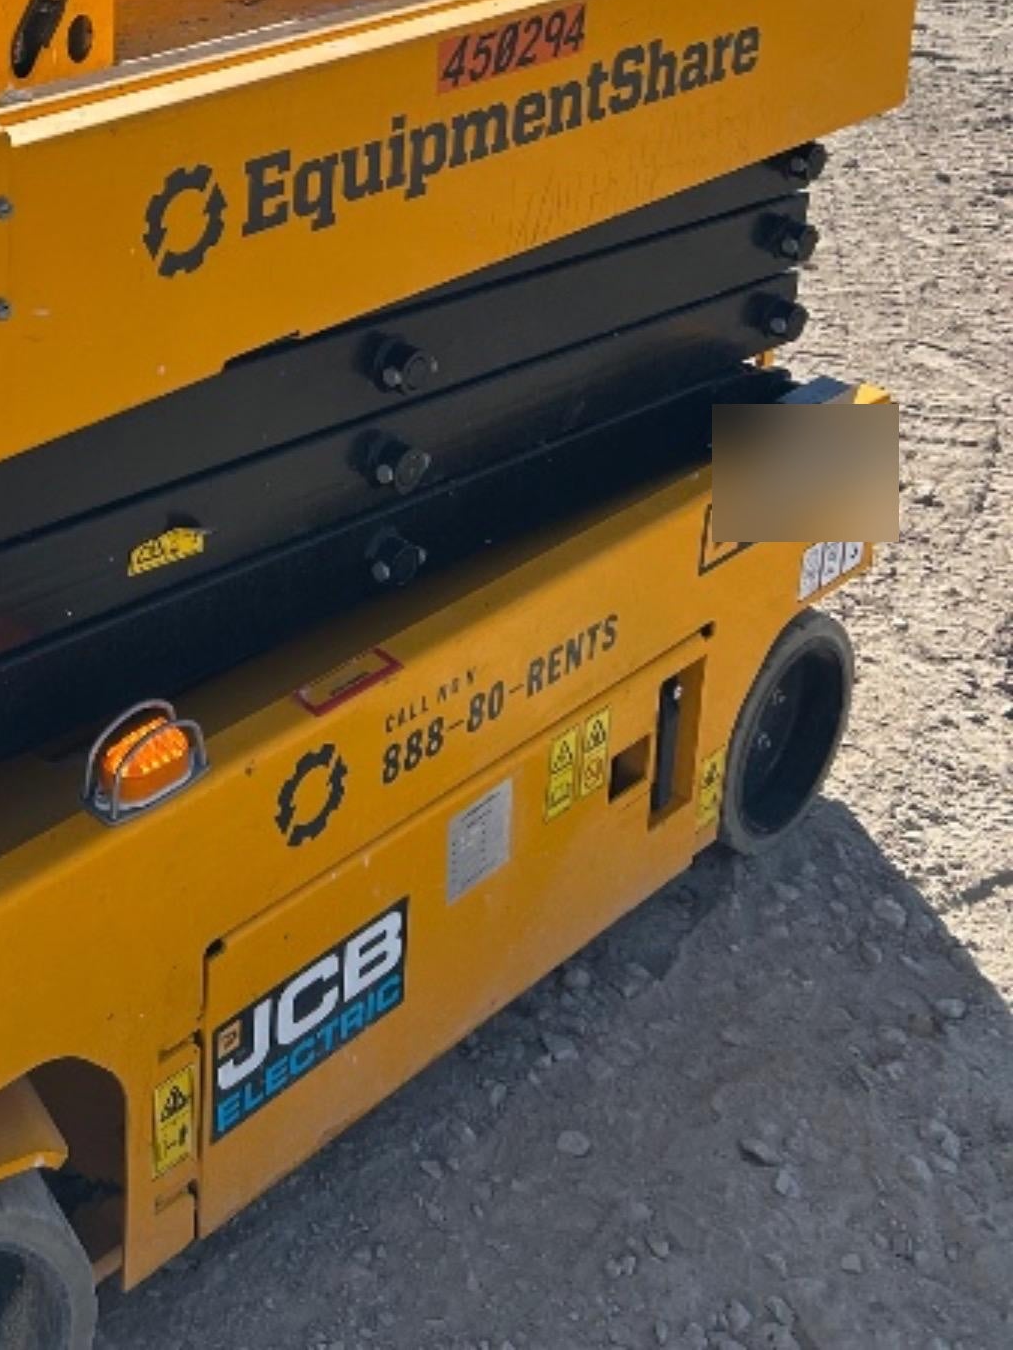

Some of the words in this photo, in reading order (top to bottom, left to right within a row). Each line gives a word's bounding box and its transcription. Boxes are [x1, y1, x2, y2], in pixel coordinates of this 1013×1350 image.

[441, 5, 586, 87] 450294
[241, 25, 761, 238] EquipmentShare
[382, 613, 619, 785] 888-80-RENTS
[385, 695, 429, 733] CALL
[216, 973, 401, 1133] ELECTRIC
[217, 910, 403, 1091] JCB
